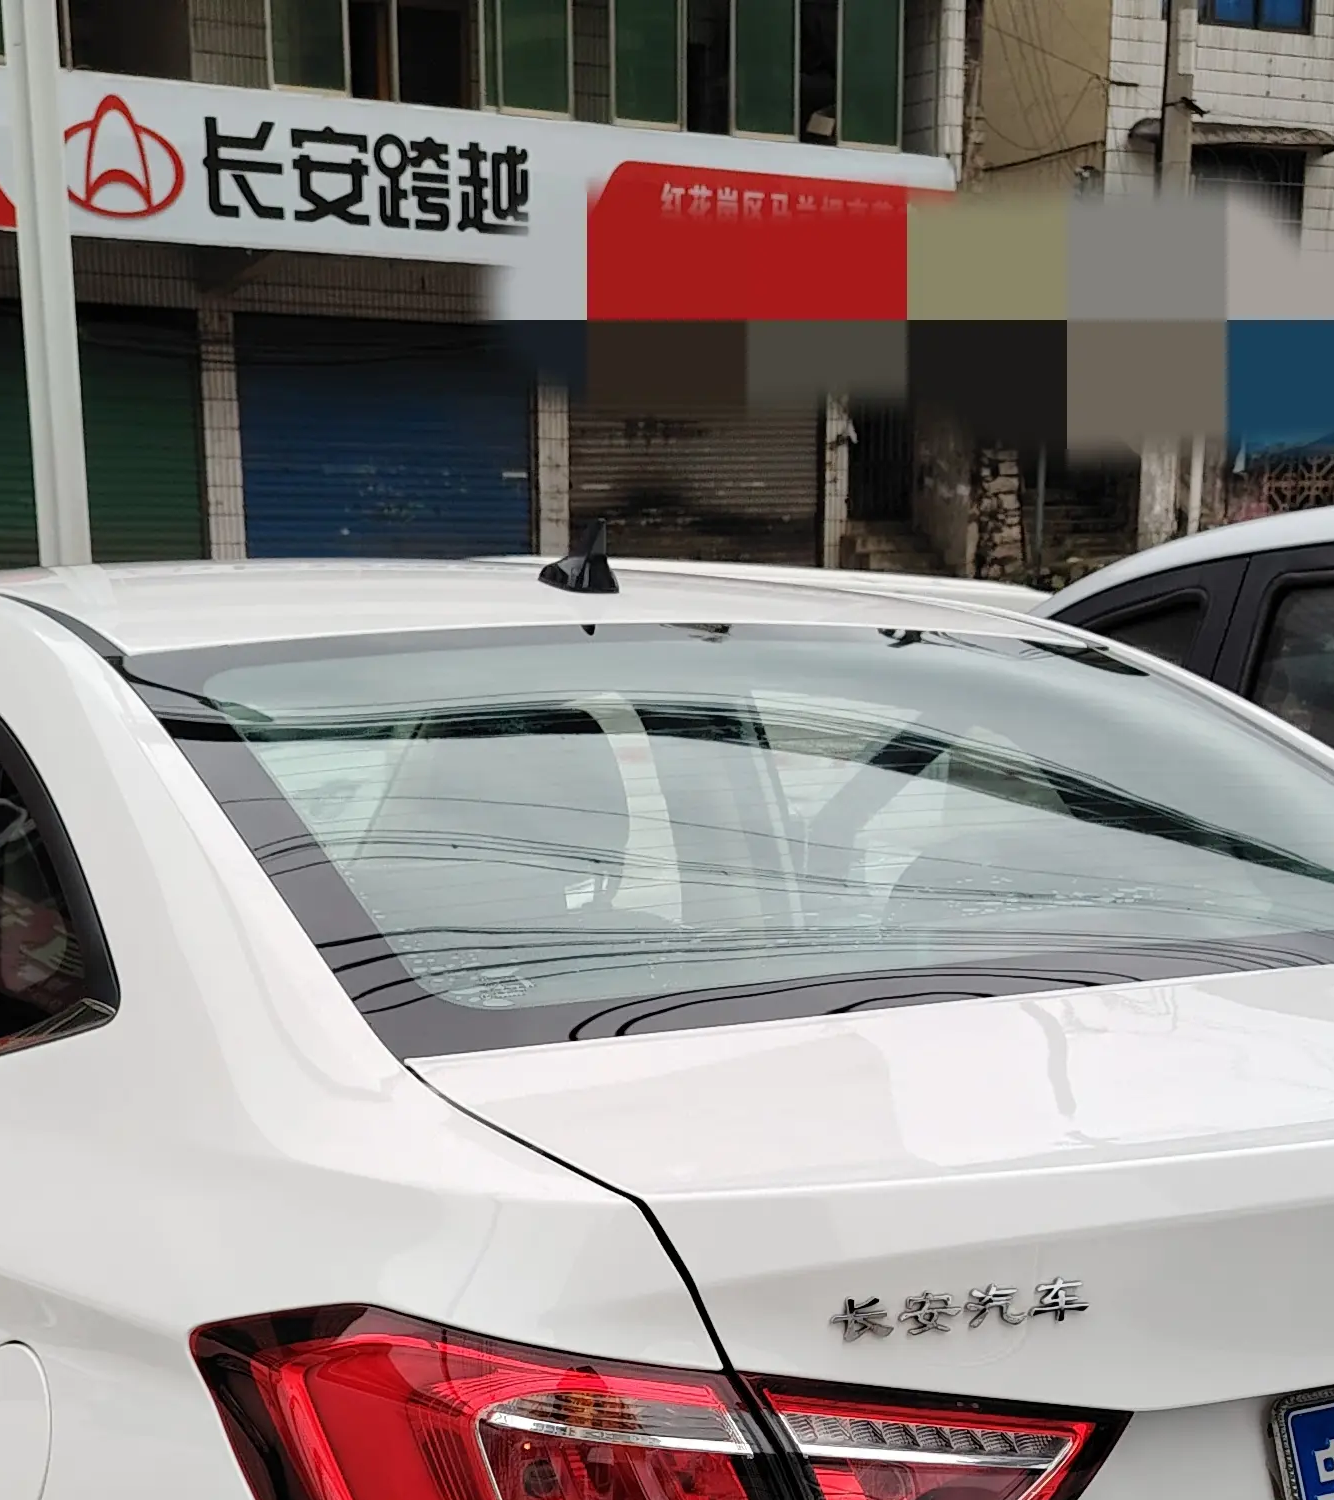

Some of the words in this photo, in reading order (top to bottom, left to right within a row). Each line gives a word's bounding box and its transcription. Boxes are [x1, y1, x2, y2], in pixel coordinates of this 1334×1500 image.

[203, 116, 529, 236] 长安跨越
[830, 1277, 1090, 1342] 长安汽车
